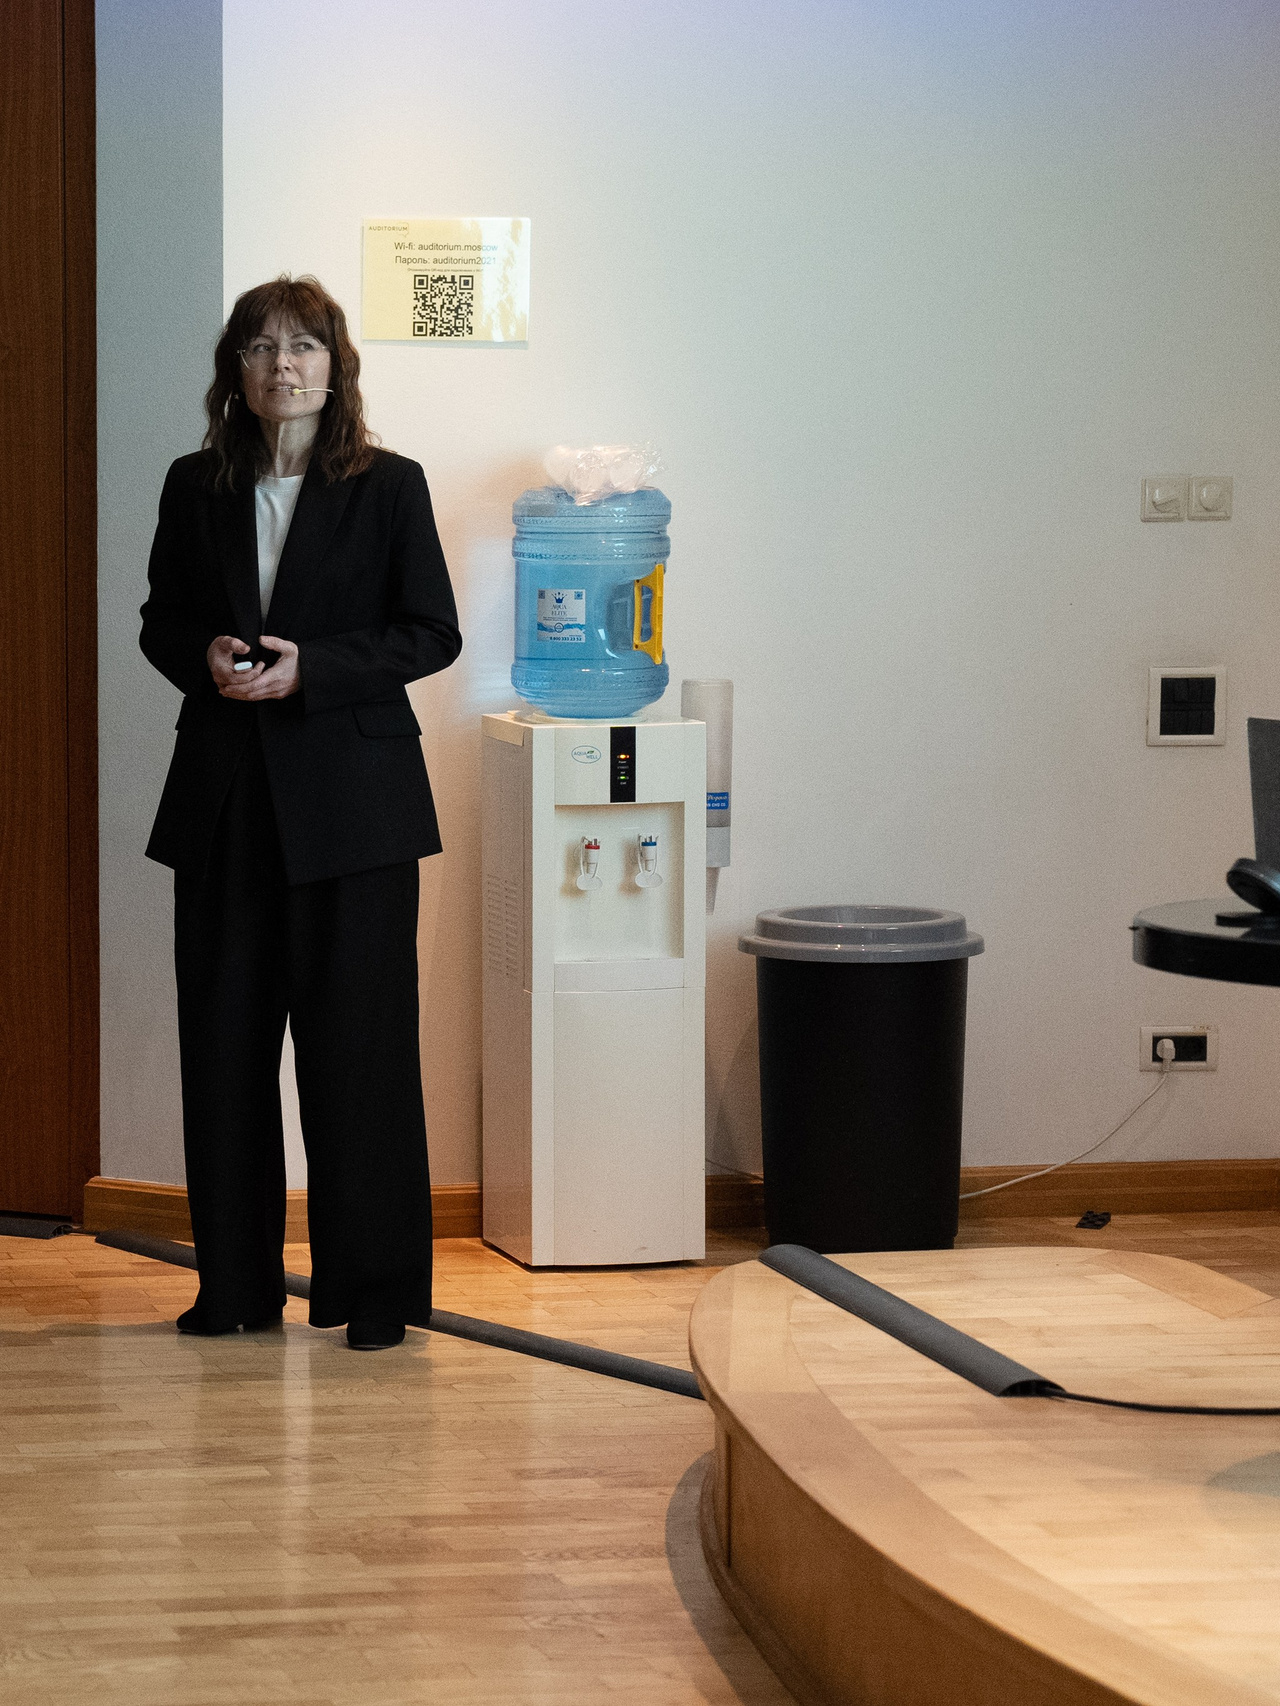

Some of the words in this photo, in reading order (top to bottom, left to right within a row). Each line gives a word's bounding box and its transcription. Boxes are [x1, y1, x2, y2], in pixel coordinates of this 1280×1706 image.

[394, 242, 416, 251] Wi-fi:
[418, 242, 498, 252] auditorium.moscow
[395, 255, 430, 265] Пароль:
[432, 256, 496, 265] auditorium2021
